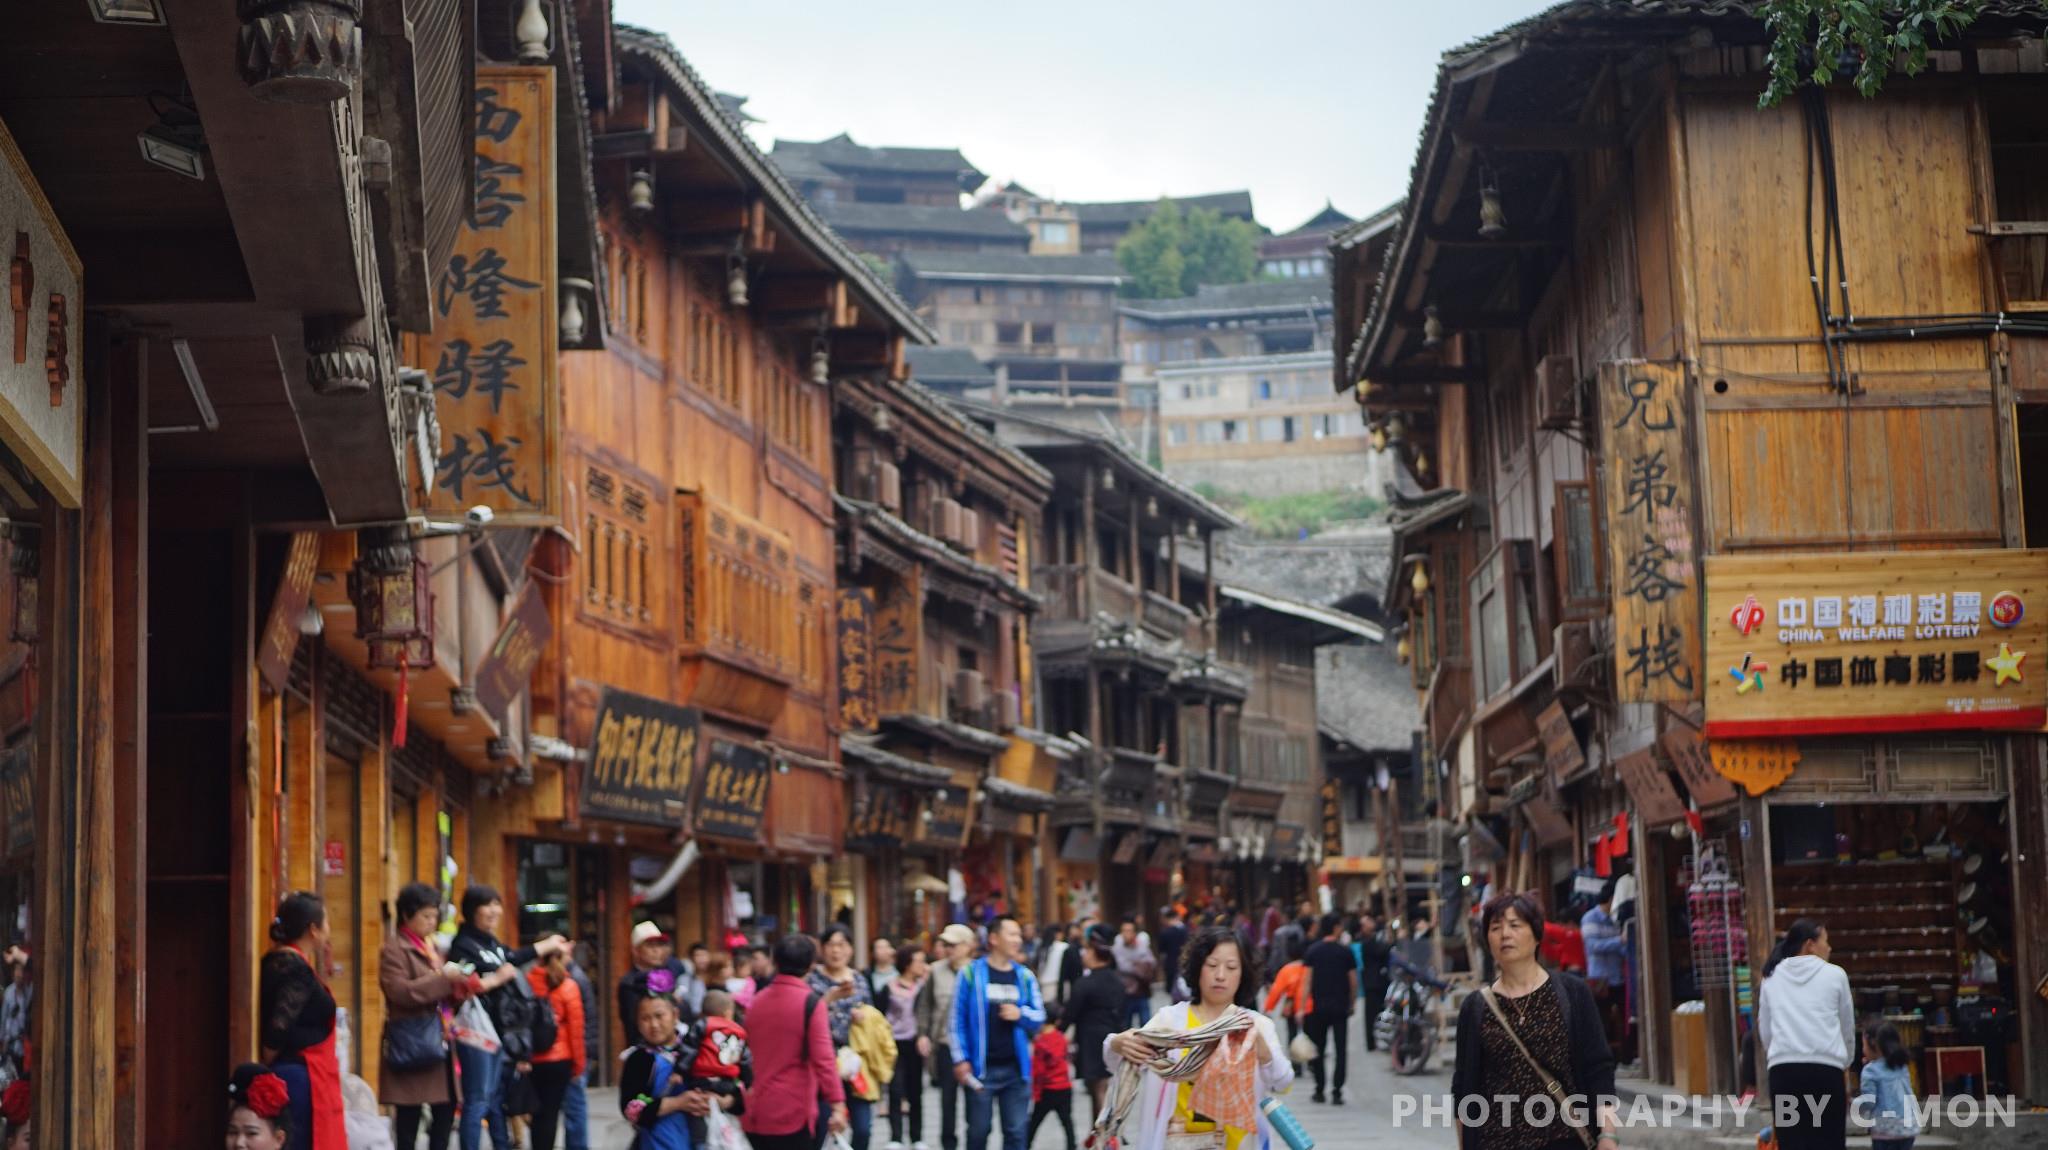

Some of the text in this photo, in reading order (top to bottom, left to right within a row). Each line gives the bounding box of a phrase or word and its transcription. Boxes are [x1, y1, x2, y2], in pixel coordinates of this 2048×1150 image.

[1613, 374, 1693, 692] 兄弟客栈
[1777, 591, 1981, 628] 中国福利彩票
[1778, 623, 1981, 642] CHINA WELFARE LOTTERY
[1781, 651, 1981, 689] 中国体育彩票
